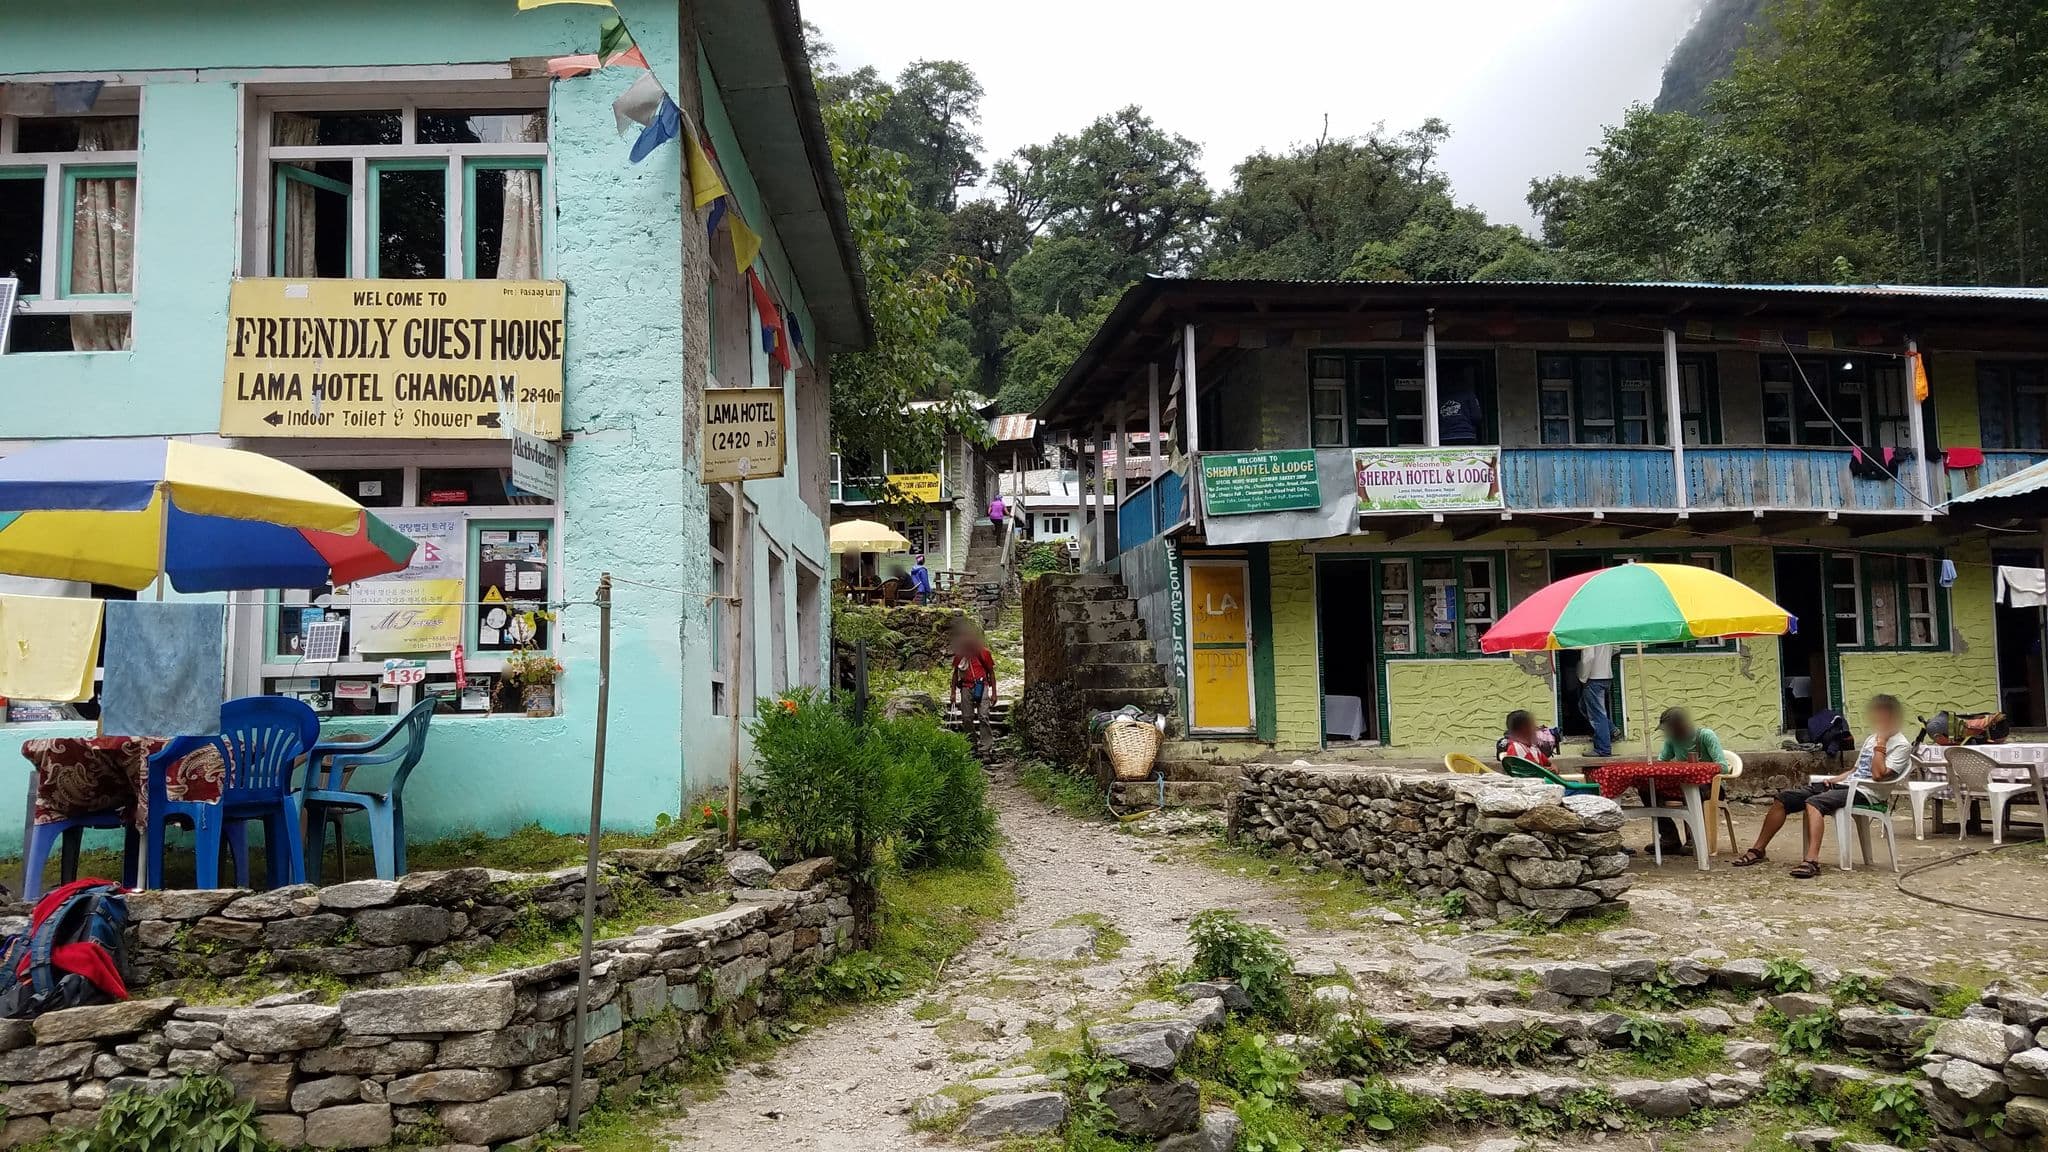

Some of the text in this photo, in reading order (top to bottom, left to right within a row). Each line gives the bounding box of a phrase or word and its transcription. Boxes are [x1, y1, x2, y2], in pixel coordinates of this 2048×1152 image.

[429, 292, 447, 306] TO
[232, 316, 563, 361] FRIENDLY GUEST HOUSE
[237, 372, 303, 401] LAMA
[311, 372, 383, 401] HOTEL
[287, 409, 335, 427] Indoor
[342, 409, 387, 427] Toilet
[413, 408, 473, 428] Shower
[706, 402, 776, 424] LAMA HOTEL
[1206, 460, 1314, 478] SHERPA HOTEL & LODGE
[1237, 456, 1268, 465] WELCOME
[1359, 468, 1495, 486] SHERPA HOTEL & LODGE
[1206, 593, 1239, 615] LA
[387, 669, 424, 683] 136
